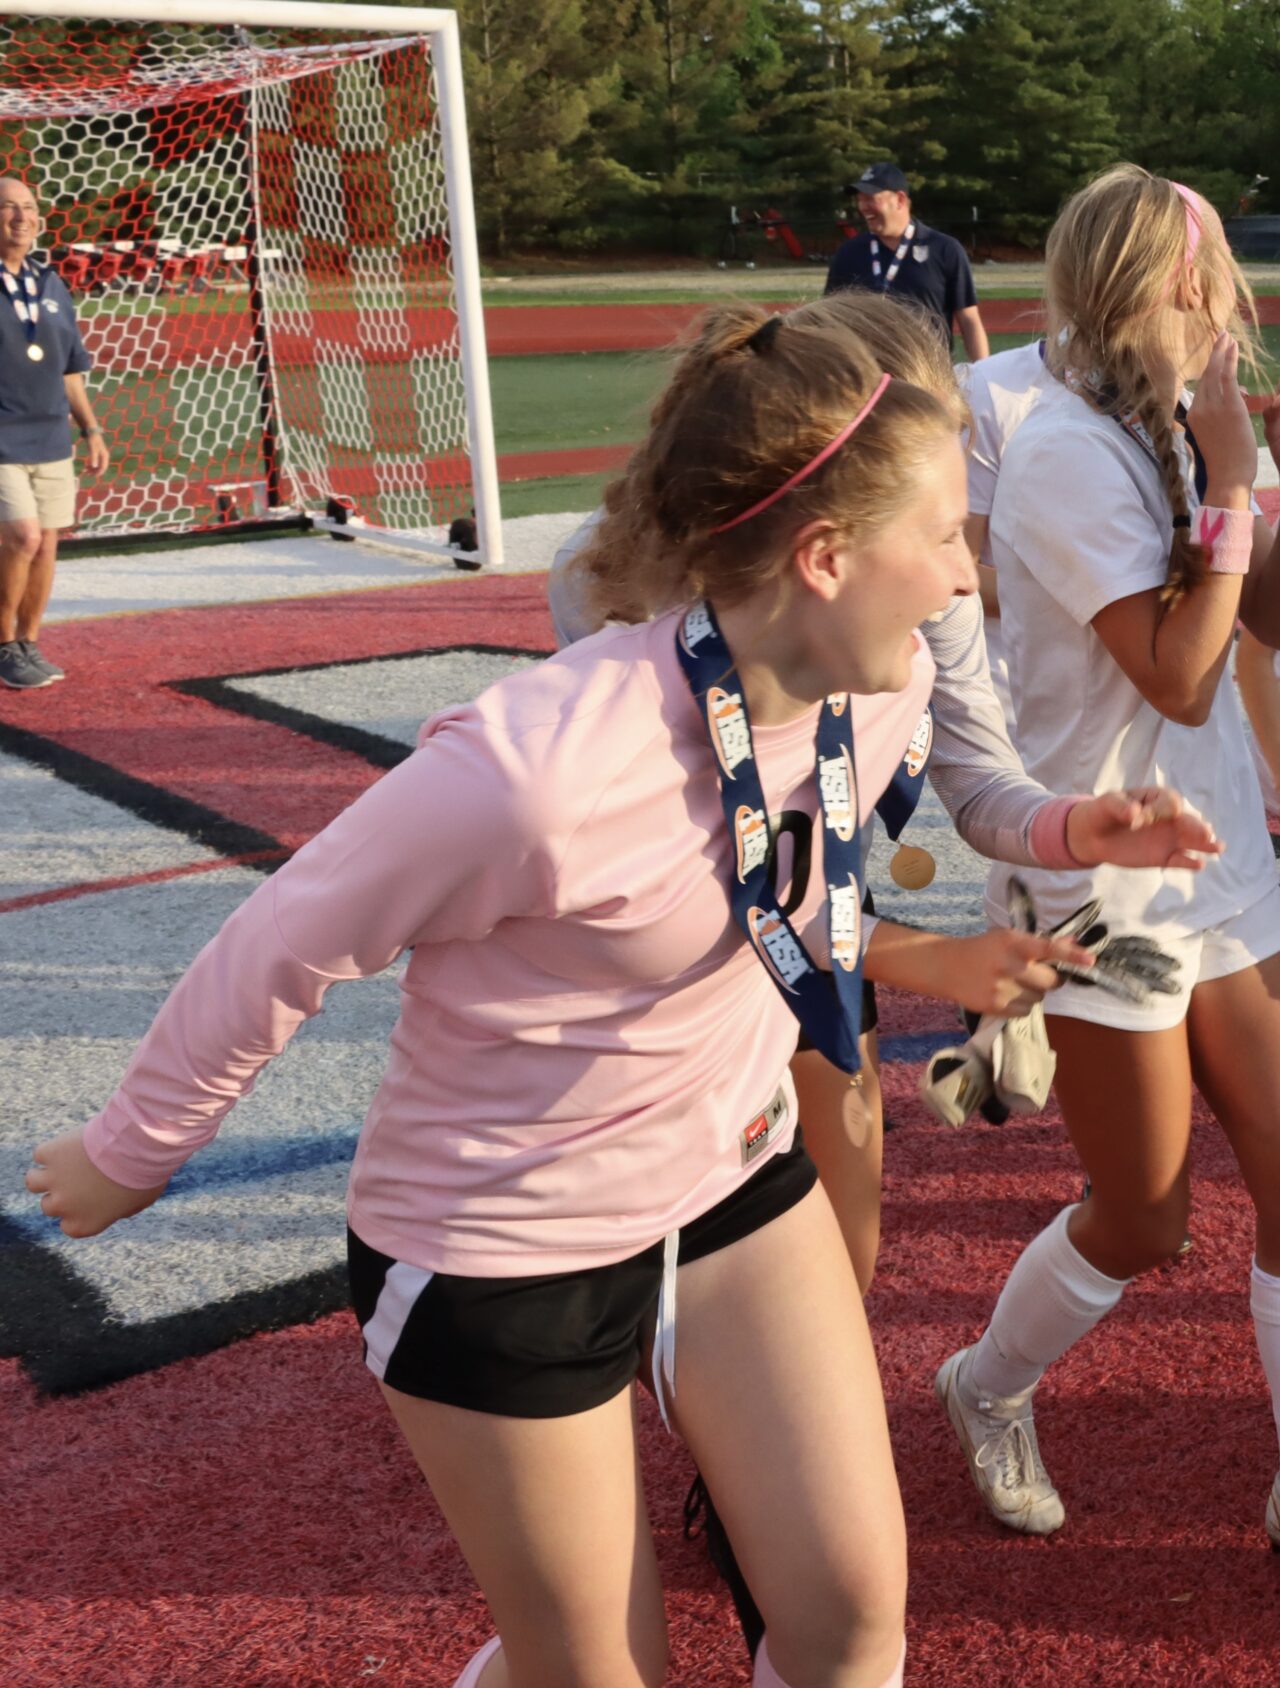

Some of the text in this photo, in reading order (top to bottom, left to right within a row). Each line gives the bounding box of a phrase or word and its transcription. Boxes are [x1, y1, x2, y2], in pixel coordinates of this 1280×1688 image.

[712, 693, 751, 770] IHSA
[820, 756, 852, 828] IHSA
[755, 909, 810, 985] IHSA
[830, 885, 856, 959] IHSA
